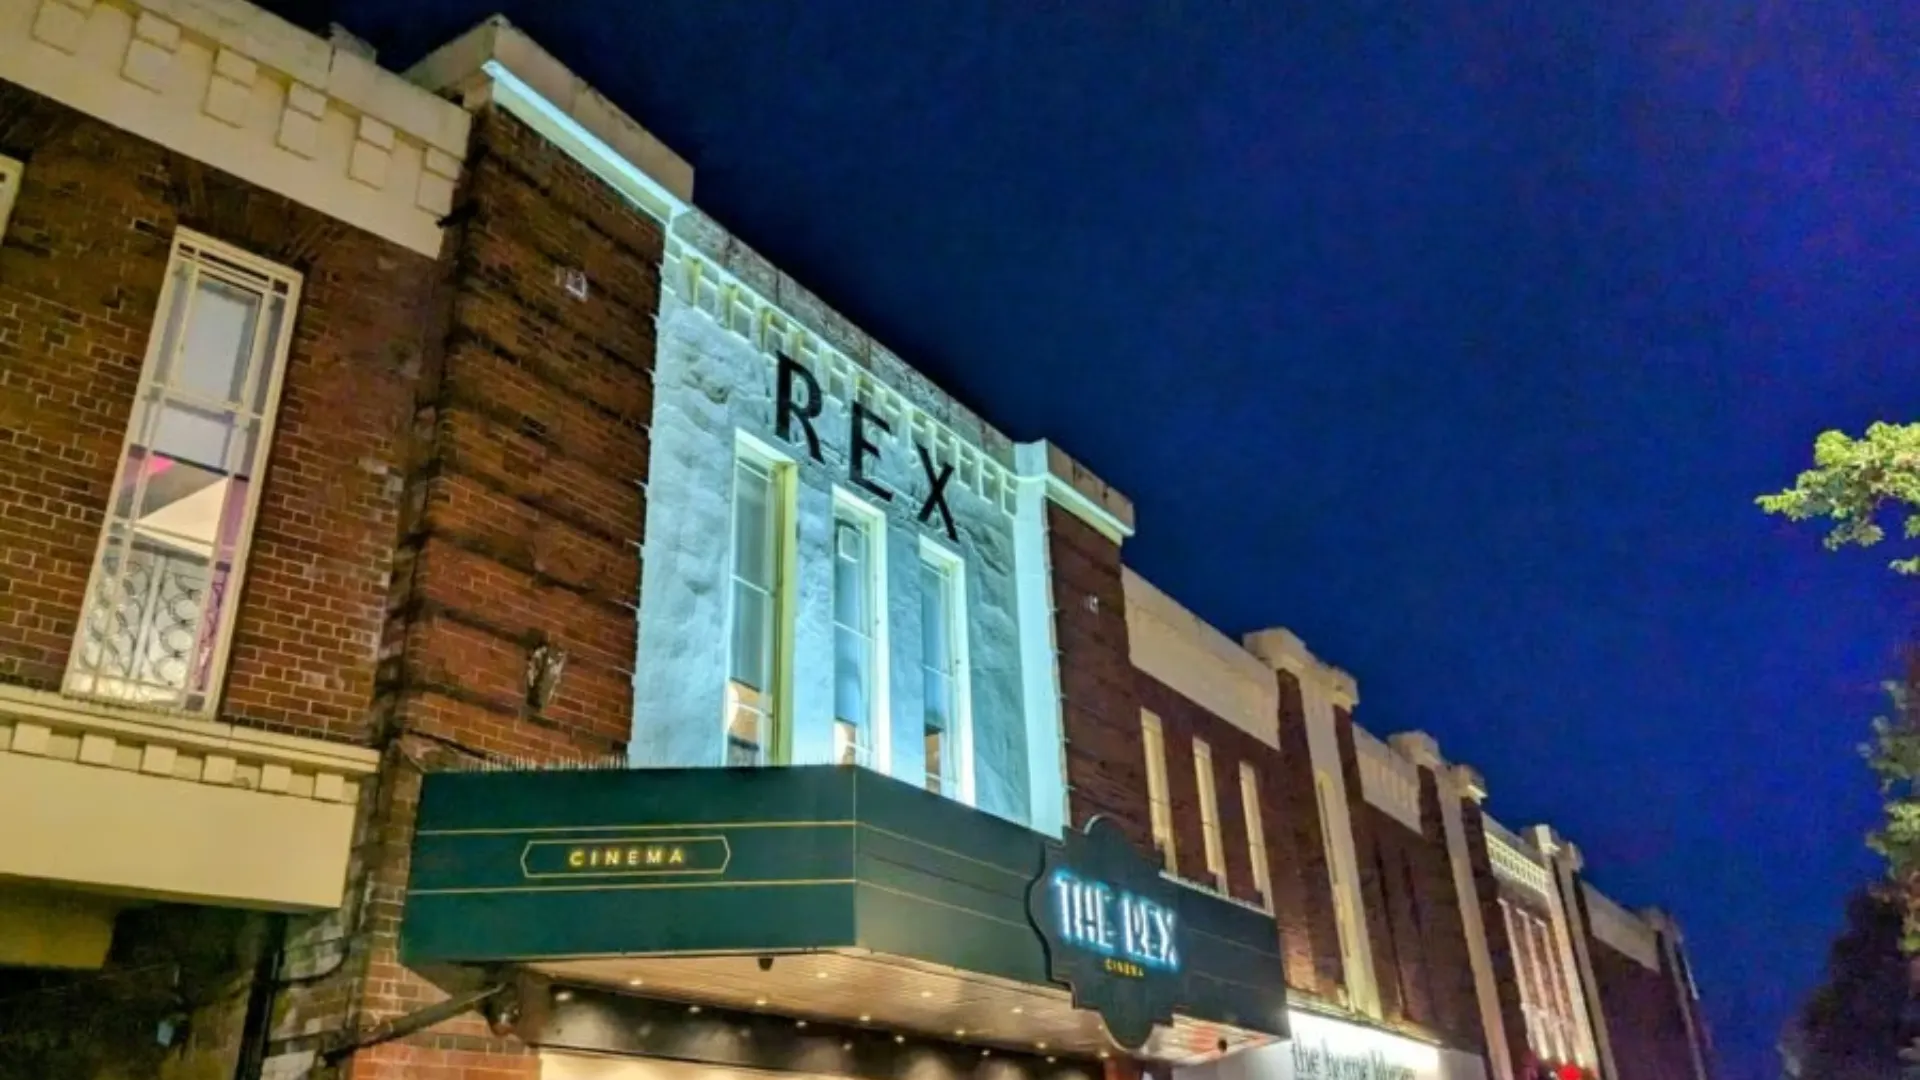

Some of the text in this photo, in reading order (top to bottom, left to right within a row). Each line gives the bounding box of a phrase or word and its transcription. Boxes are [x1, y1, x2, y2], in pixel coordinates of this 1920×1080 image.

[775, 349, 959, 542] REX
[568, 848, 684, 866] CINEMA
[1054, 871, 1178, 970] THE REX
[1103, 957, 1145, 977] CINEMA
[1291, 1032, 1319, 1075] the
